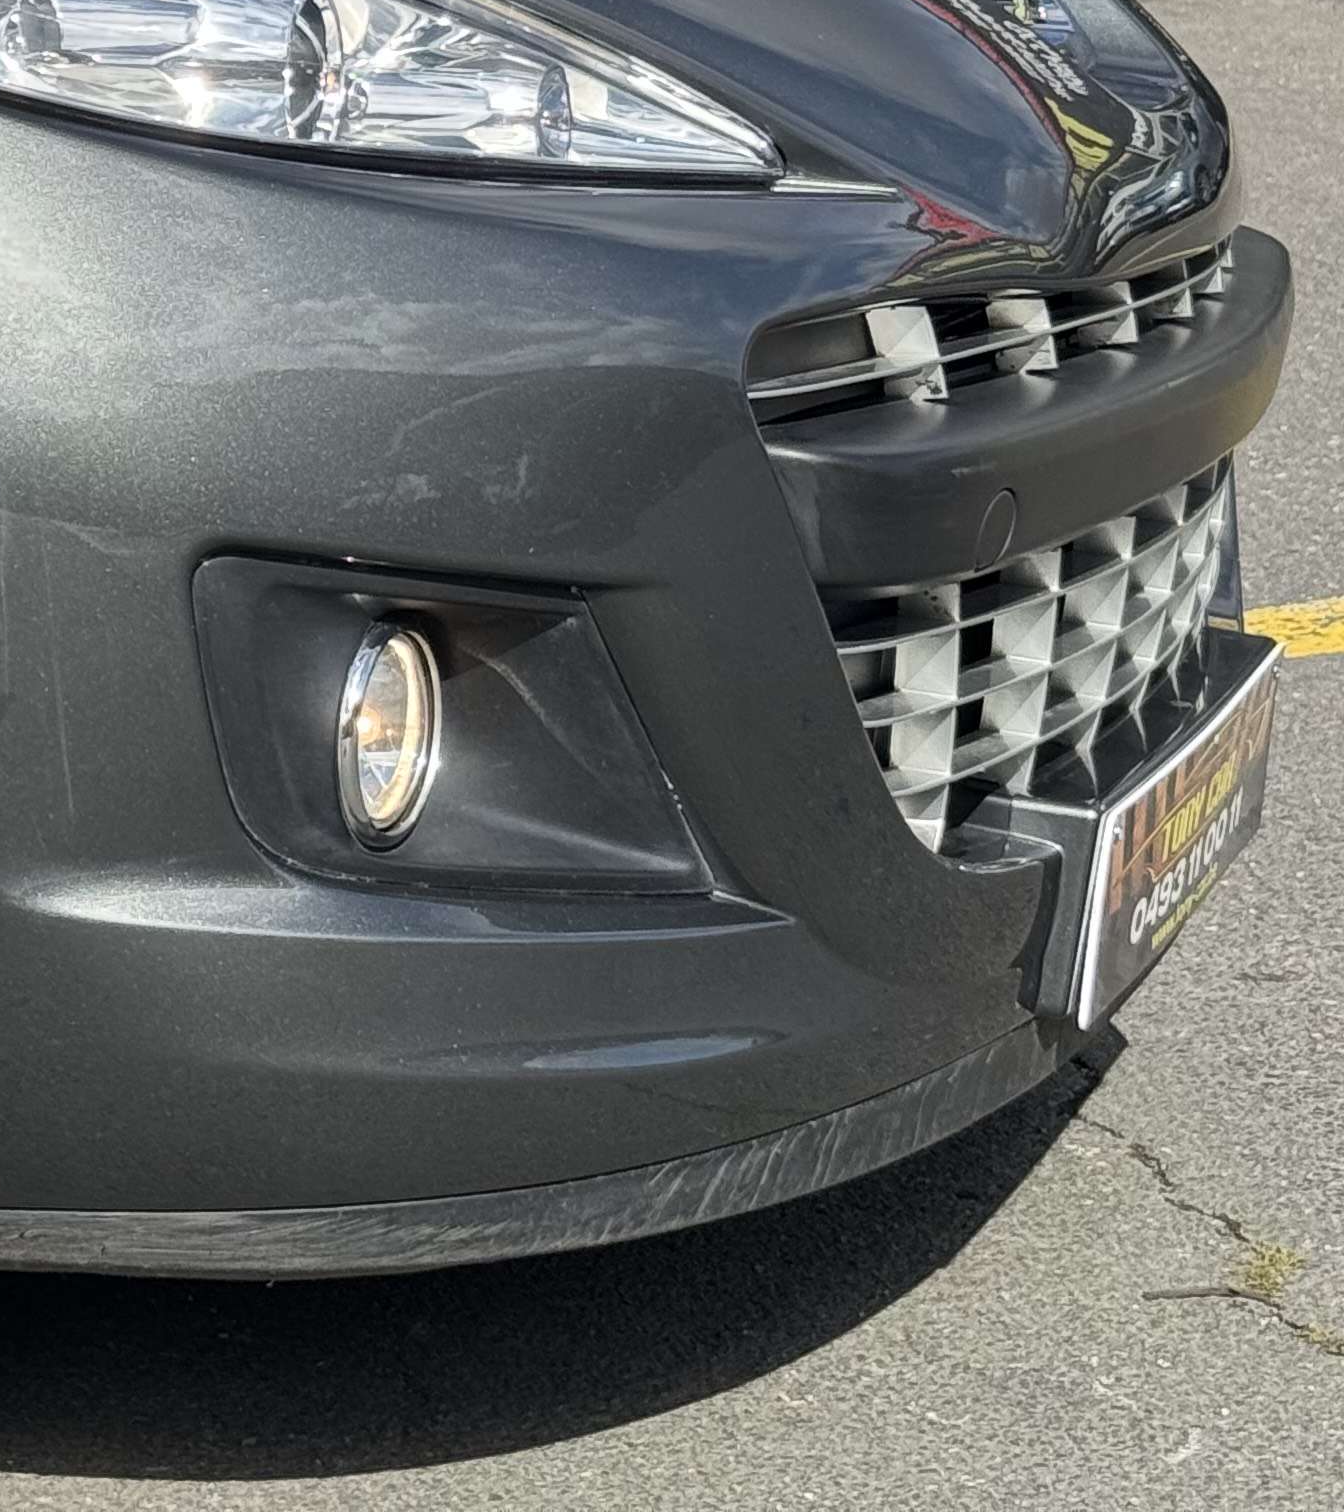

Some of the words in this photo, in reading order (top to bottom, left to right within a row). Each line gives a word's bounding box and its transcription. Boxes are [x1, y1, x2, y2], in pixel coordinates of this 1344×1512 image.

[1130, 856, 1187, 945] 0493
[1204, 808, 1228, 866] 00
[1228, 784, 1243, 834] 11
[1162, 784, 1206, 863] TONY
